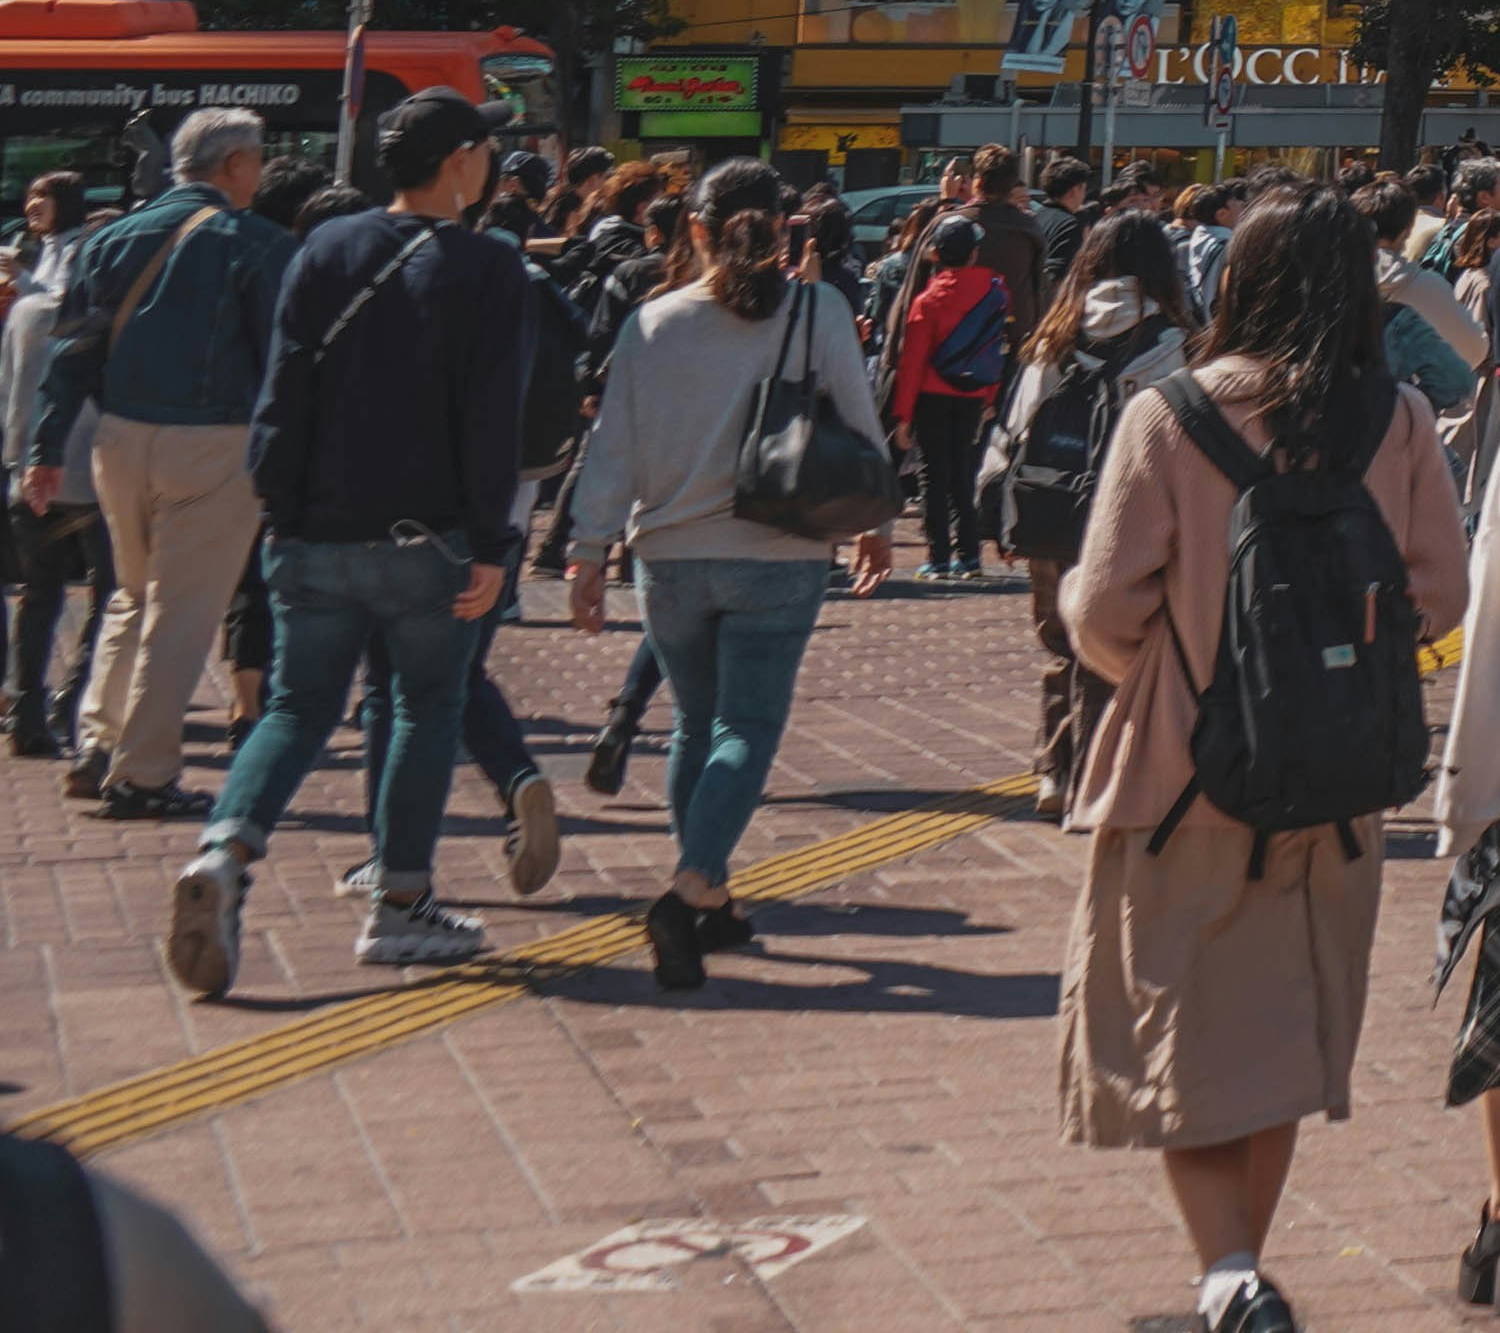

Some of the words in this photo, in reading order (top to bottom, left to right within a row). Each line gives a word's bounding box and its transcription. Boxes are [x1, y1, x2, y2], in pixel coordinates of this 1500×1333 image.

[20, 83, 147, 110] community
[153, 84, 194, 104] bus
[200, 84, 298, 105] HACHIKO
